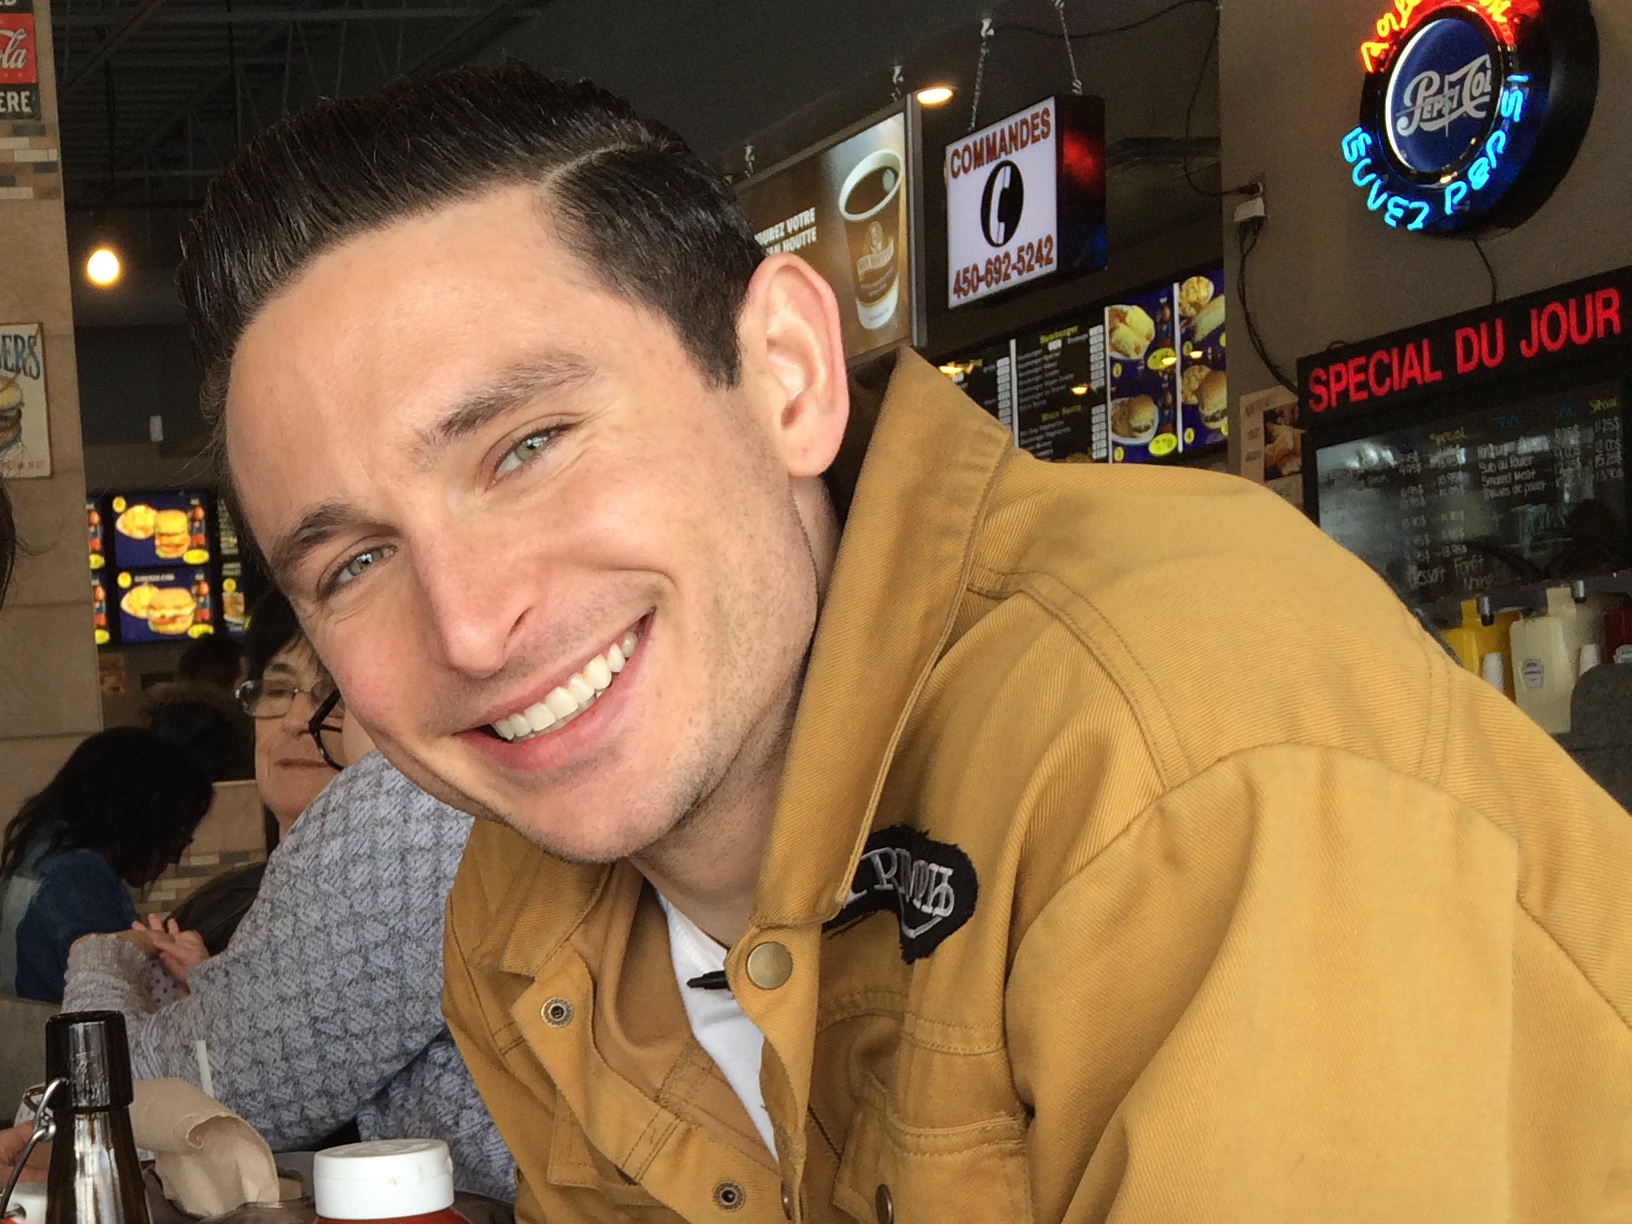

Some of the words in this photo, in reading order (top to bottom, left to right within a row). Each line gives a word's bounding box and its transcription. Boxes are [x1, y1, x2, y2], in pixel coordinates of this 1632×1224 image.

[950, 108, 1052, 179] COMMANDES
[952, 234, 1054, 299] 450-692-5242
[1308, 338, 1441, 413] SPECIAL
[1456, 319, 1504, 368] DU
[1519, 288, 1622, 358] JOUR
